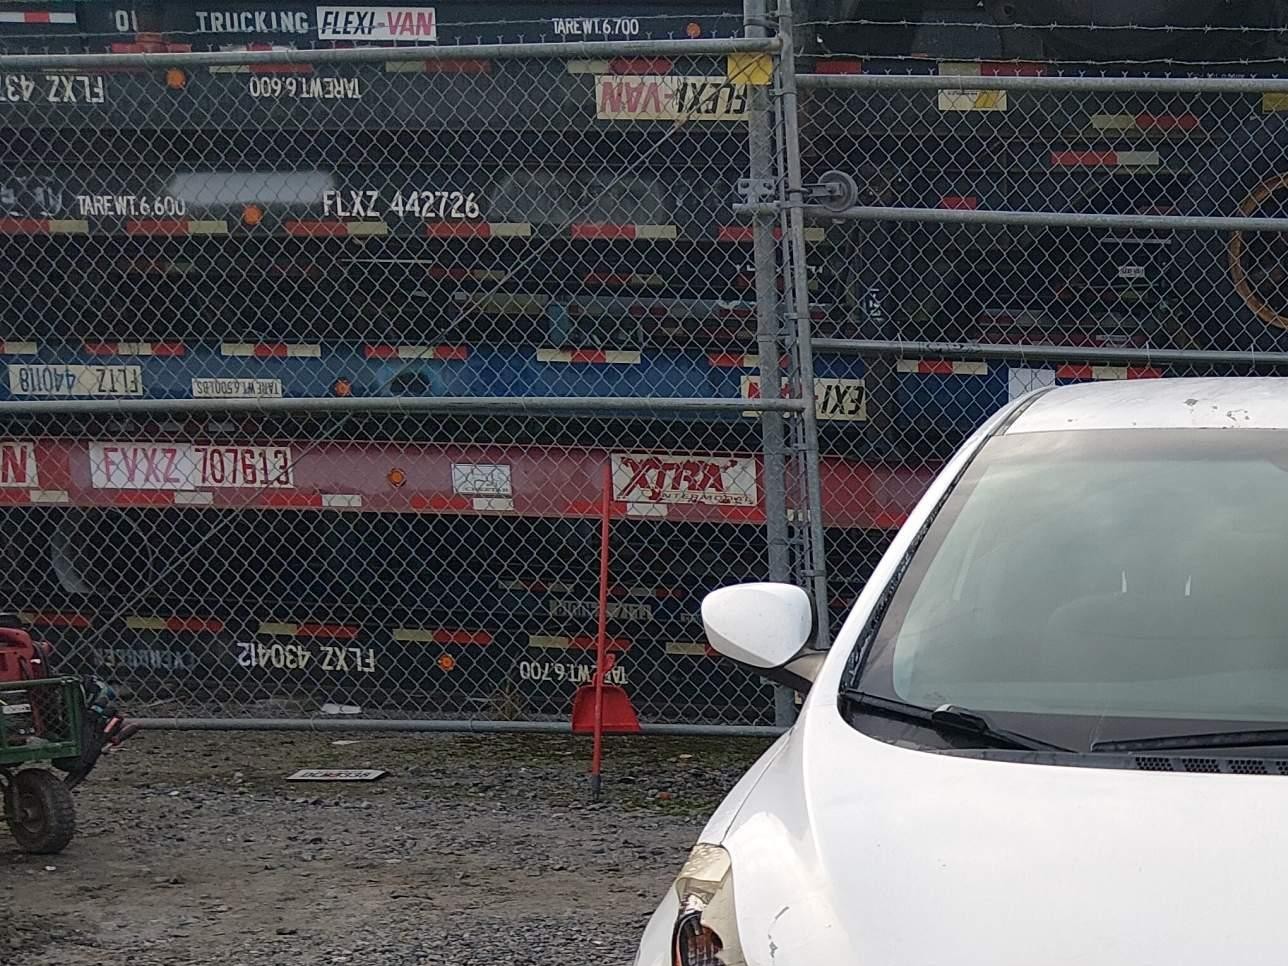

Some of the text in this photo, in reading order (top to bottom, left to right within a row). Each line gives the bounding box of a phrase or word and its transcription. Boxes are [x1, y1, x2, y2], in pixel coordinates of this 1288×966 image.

[195, 11, 309, 34] TRUCKING
[321, 11, 433, 36] FLEXI-VAN
[45, 74, 105, 103] FLXZ
[601, 82, 748, 113] FLEXI-VAN
[323, 190, 480, 219] FLXZ 442726
[616, 456, 738, 500] XTRA
[236, 642, 376, 673] FLXZ 430412
